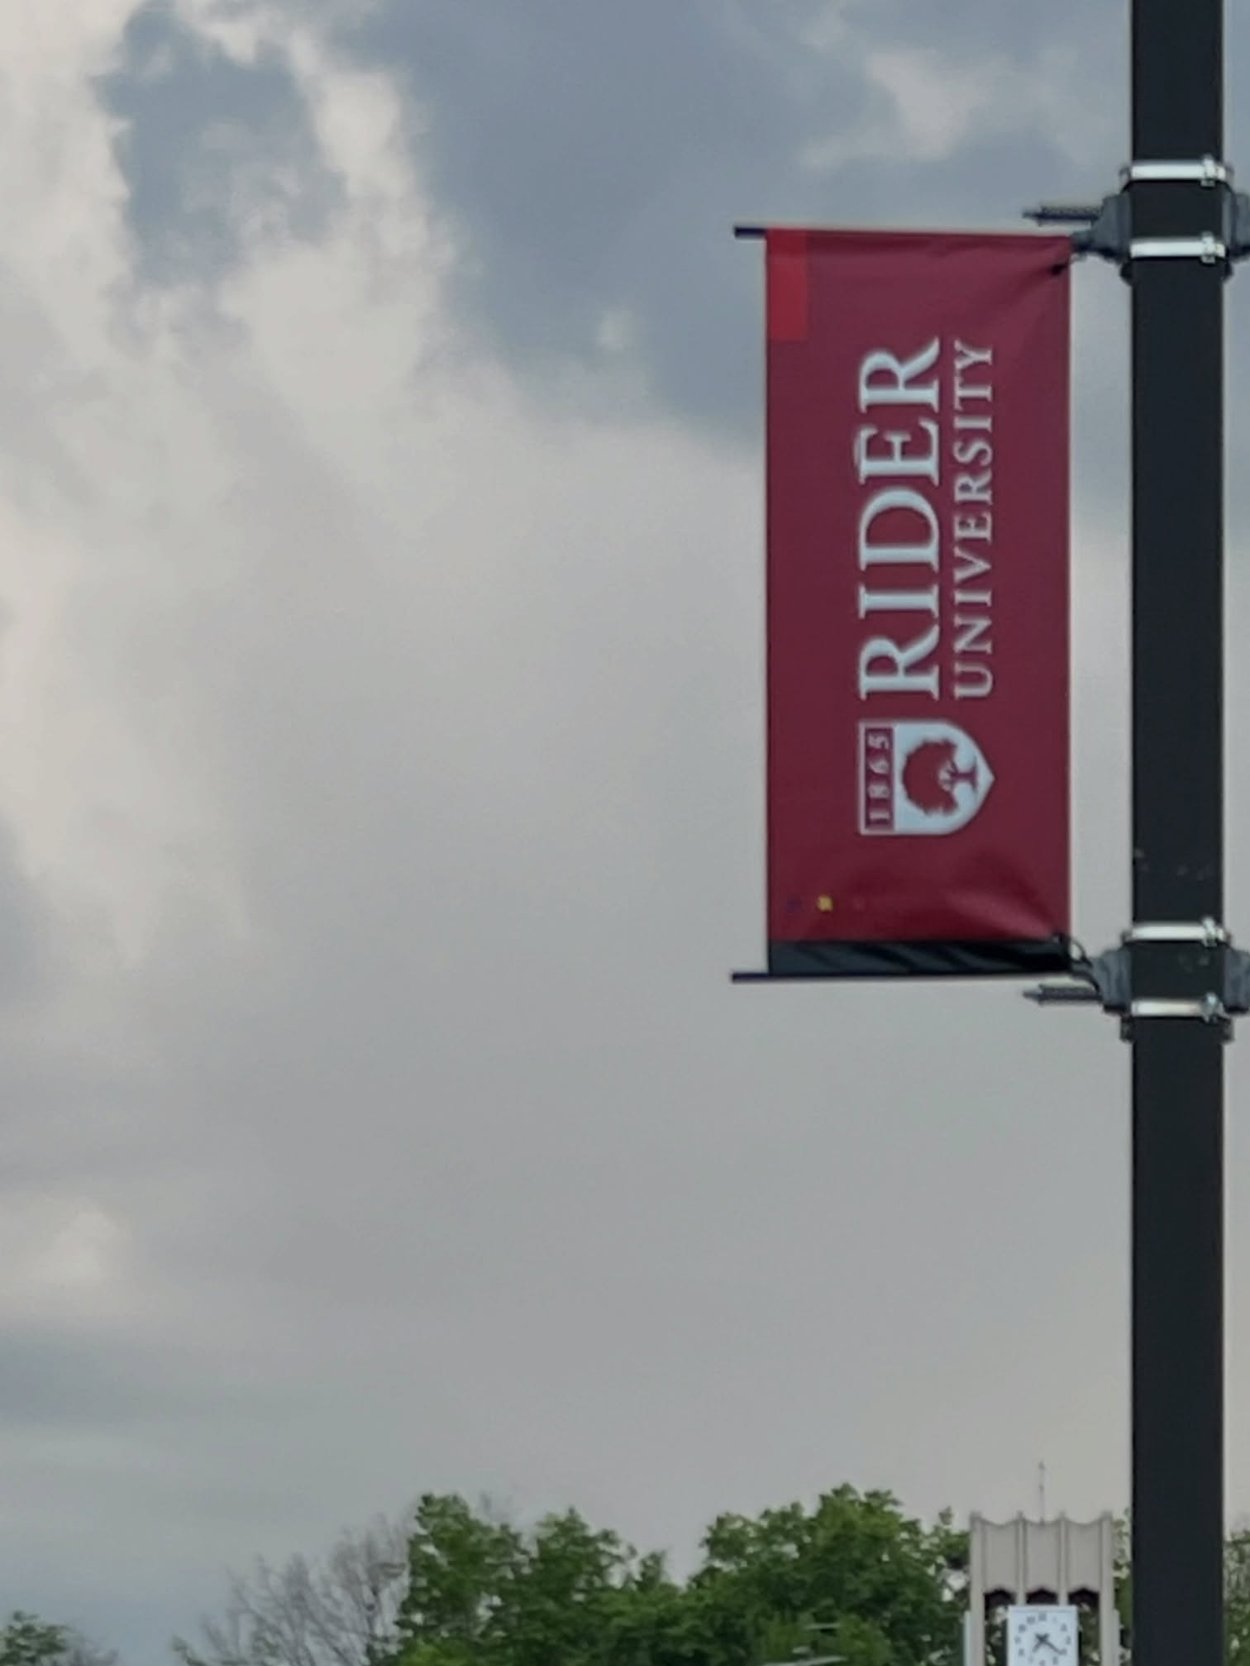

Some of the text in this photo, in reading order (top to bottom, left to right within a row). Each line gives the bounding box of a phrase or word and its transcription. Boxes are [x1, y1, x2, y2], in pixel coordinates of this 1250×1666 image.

[853, 336, 940, 700] RIDER
[953, 339, 993, 699] UNIVERSITY
[867, 732, 890, 822] 1865
